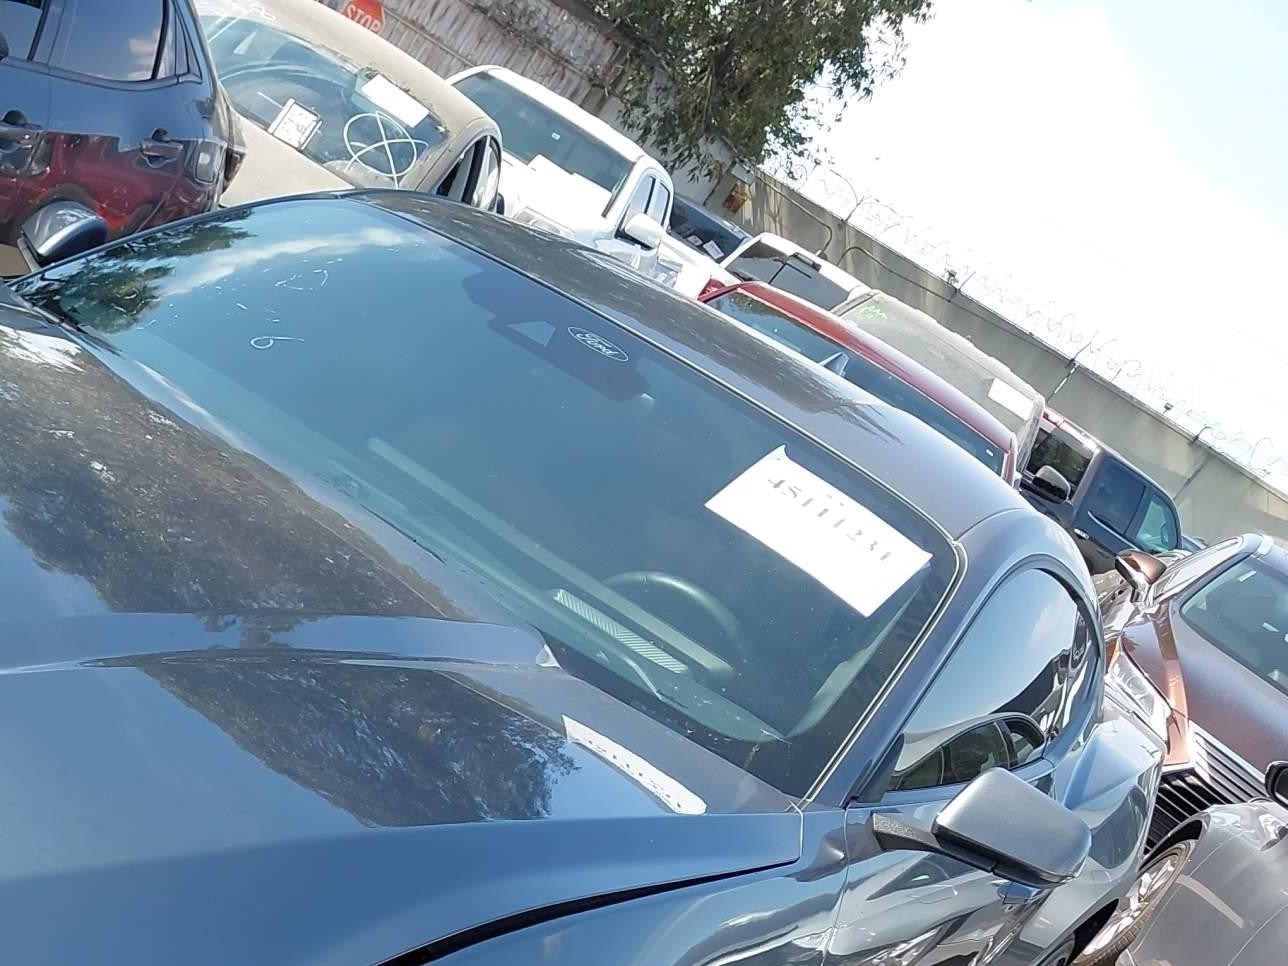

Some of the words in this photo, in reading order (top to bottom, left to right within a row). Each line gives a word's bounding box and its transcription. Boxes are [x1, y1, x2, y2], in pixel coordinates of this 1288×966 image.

[347, 4, 381, 31] STOP
[574, 332, 619, 356] Ford
[768, 479, 892, 562] 45111231
